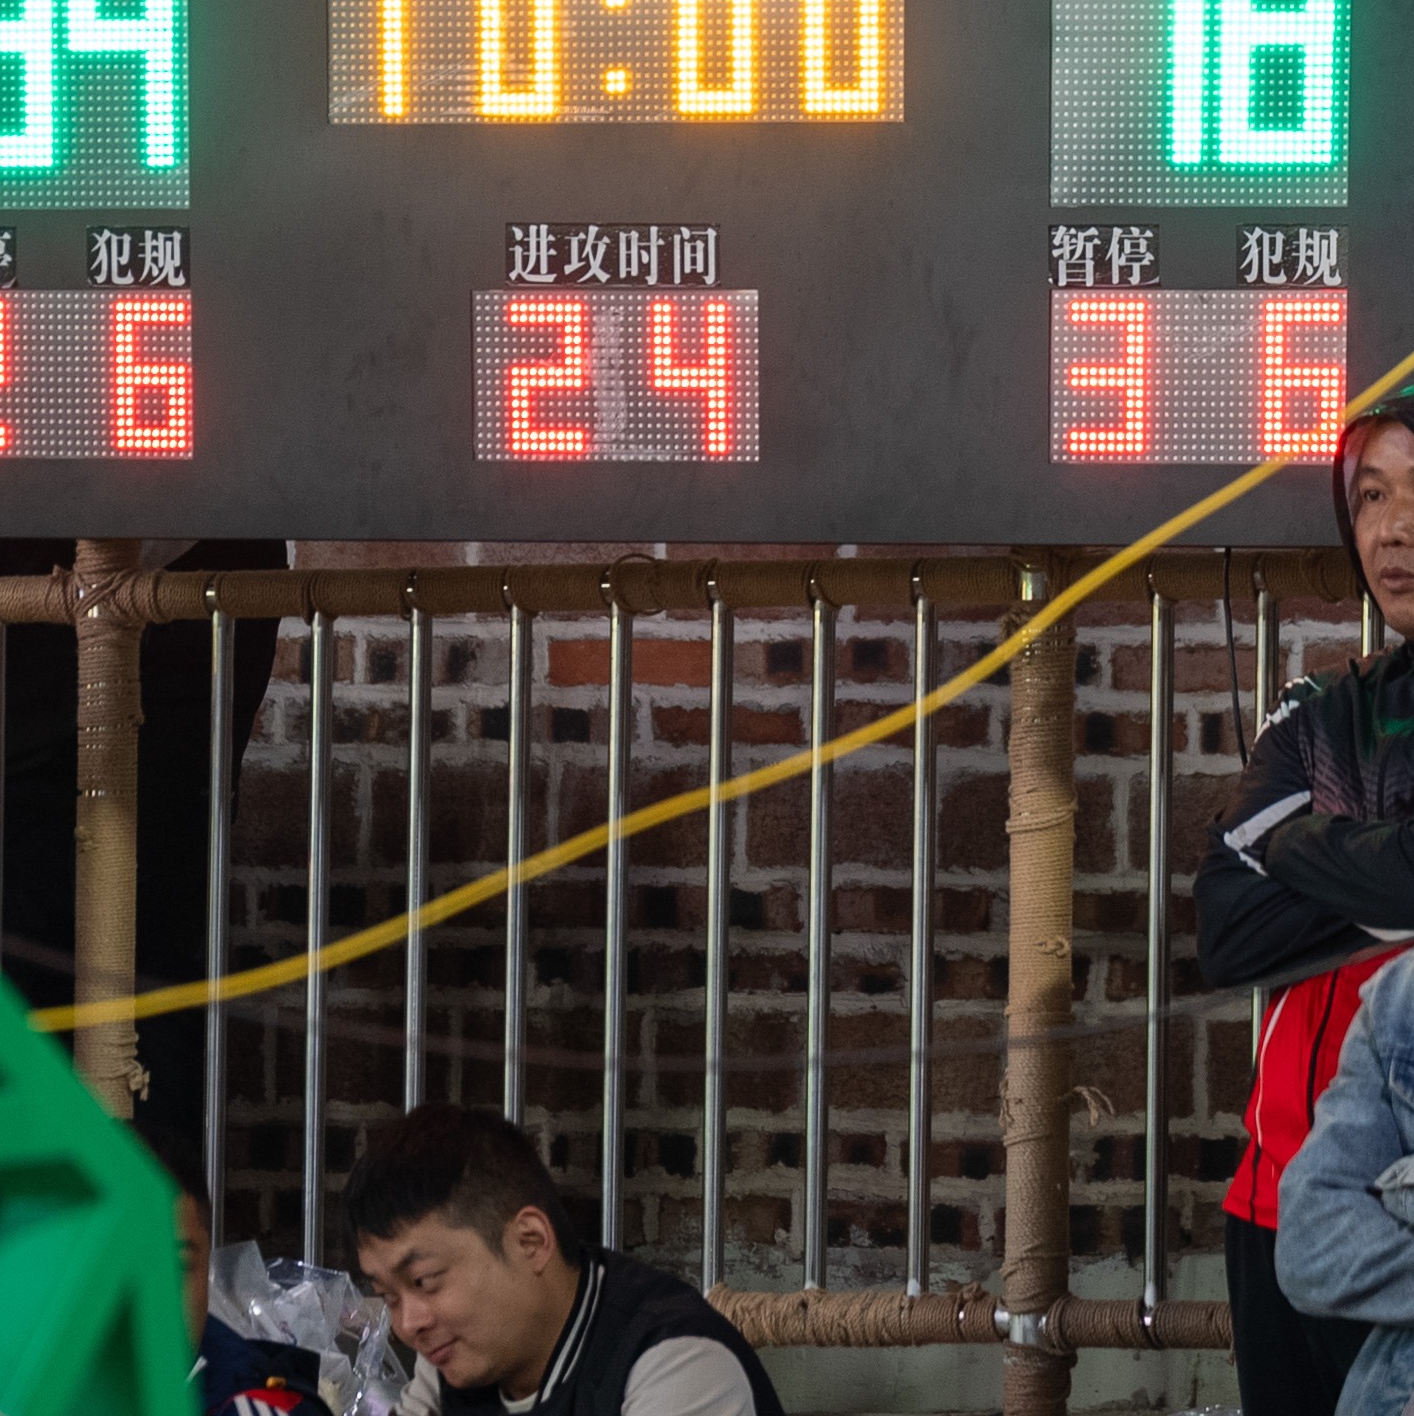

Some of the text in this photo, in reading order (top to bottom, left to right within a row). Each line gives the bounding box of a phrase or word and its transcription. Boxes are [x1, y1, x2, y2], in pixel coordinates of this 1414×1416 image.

[90, 228, 187, 286] 犯规
[508, 224, 719, 284] 进攻时间
[1052, 226, 1342, 286] 暂停 犯规
[114, 302, 188, 450] 6
[507, 302, 727, 454] 24
[1069, 300, 1341, 453] 3 6
